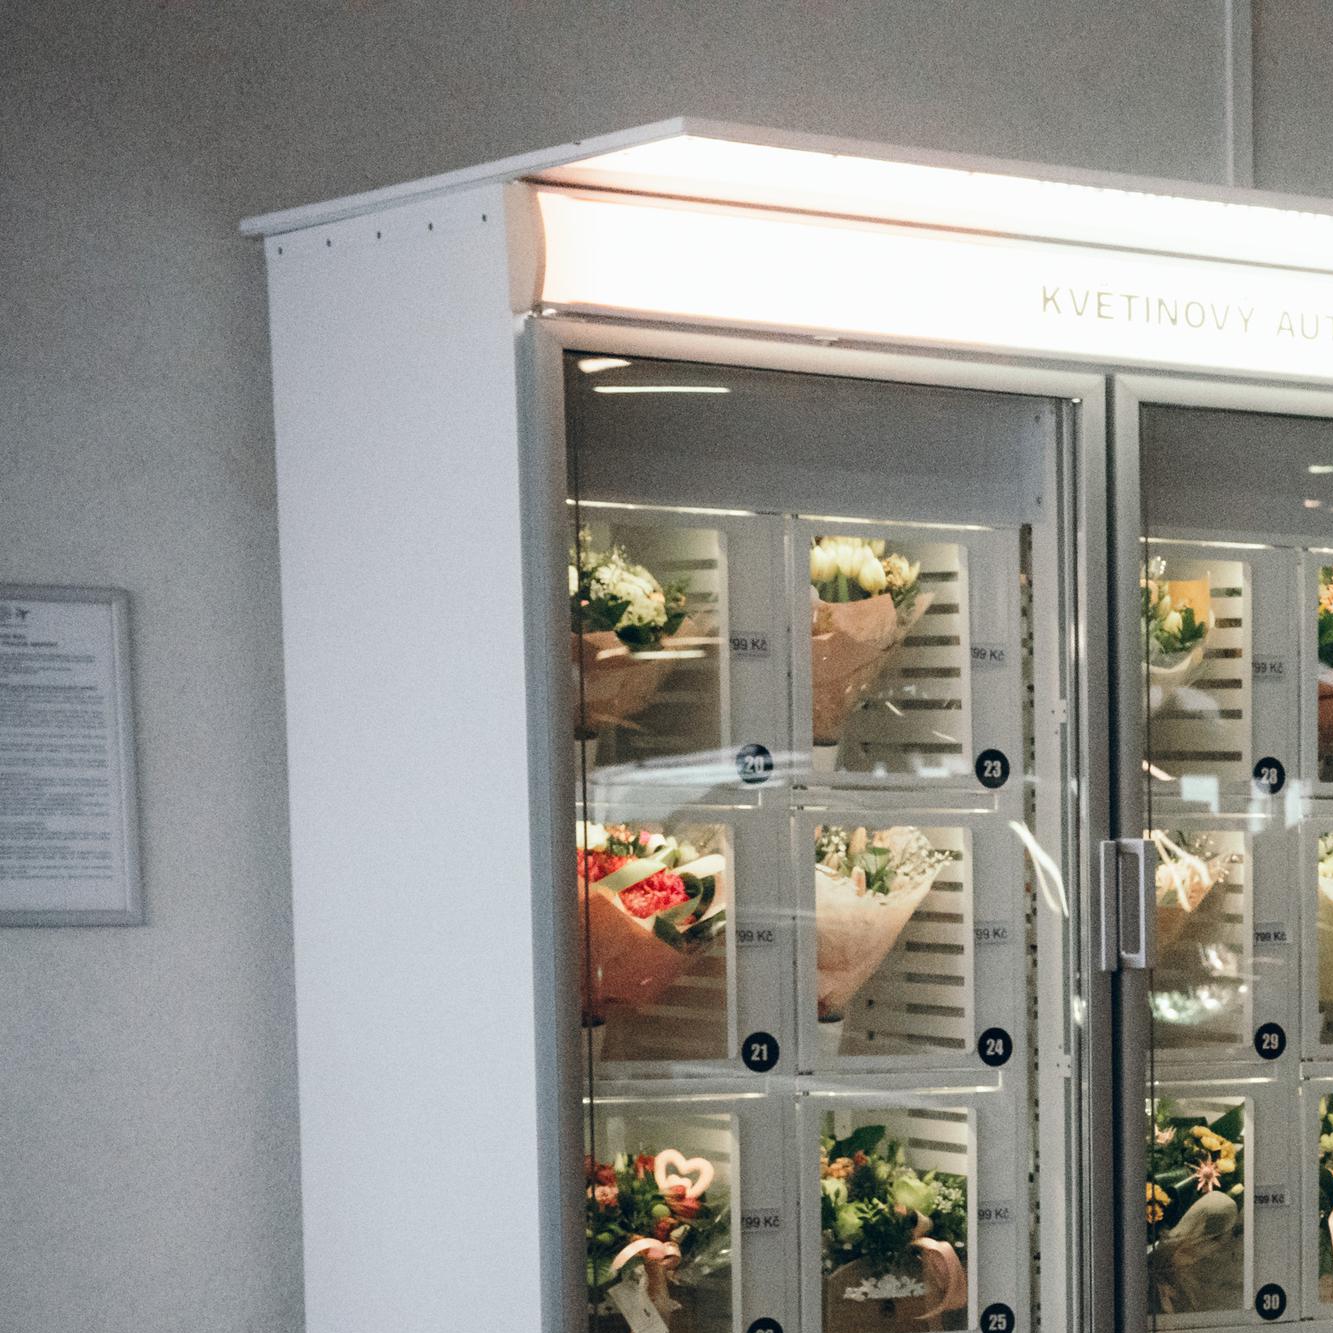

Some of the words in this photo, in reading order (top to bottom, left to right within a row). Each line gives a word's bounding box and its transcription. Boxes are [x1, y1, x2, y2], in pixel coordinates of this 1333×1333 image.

[730, 638, 748, 651] 99
[745, 755, 764, 772] 20
[984, 760, 1001, 777] 23
[736, 930, 754, 943] 99
[986, 1039, 1003, 1056] 24
[1262, 1033, 1279, 1049] 29
[751, 1044, 768, 1061] 21
[1263, 1294, 1279, 1310] 30
[989, 1314, 1007, 1331] 25
